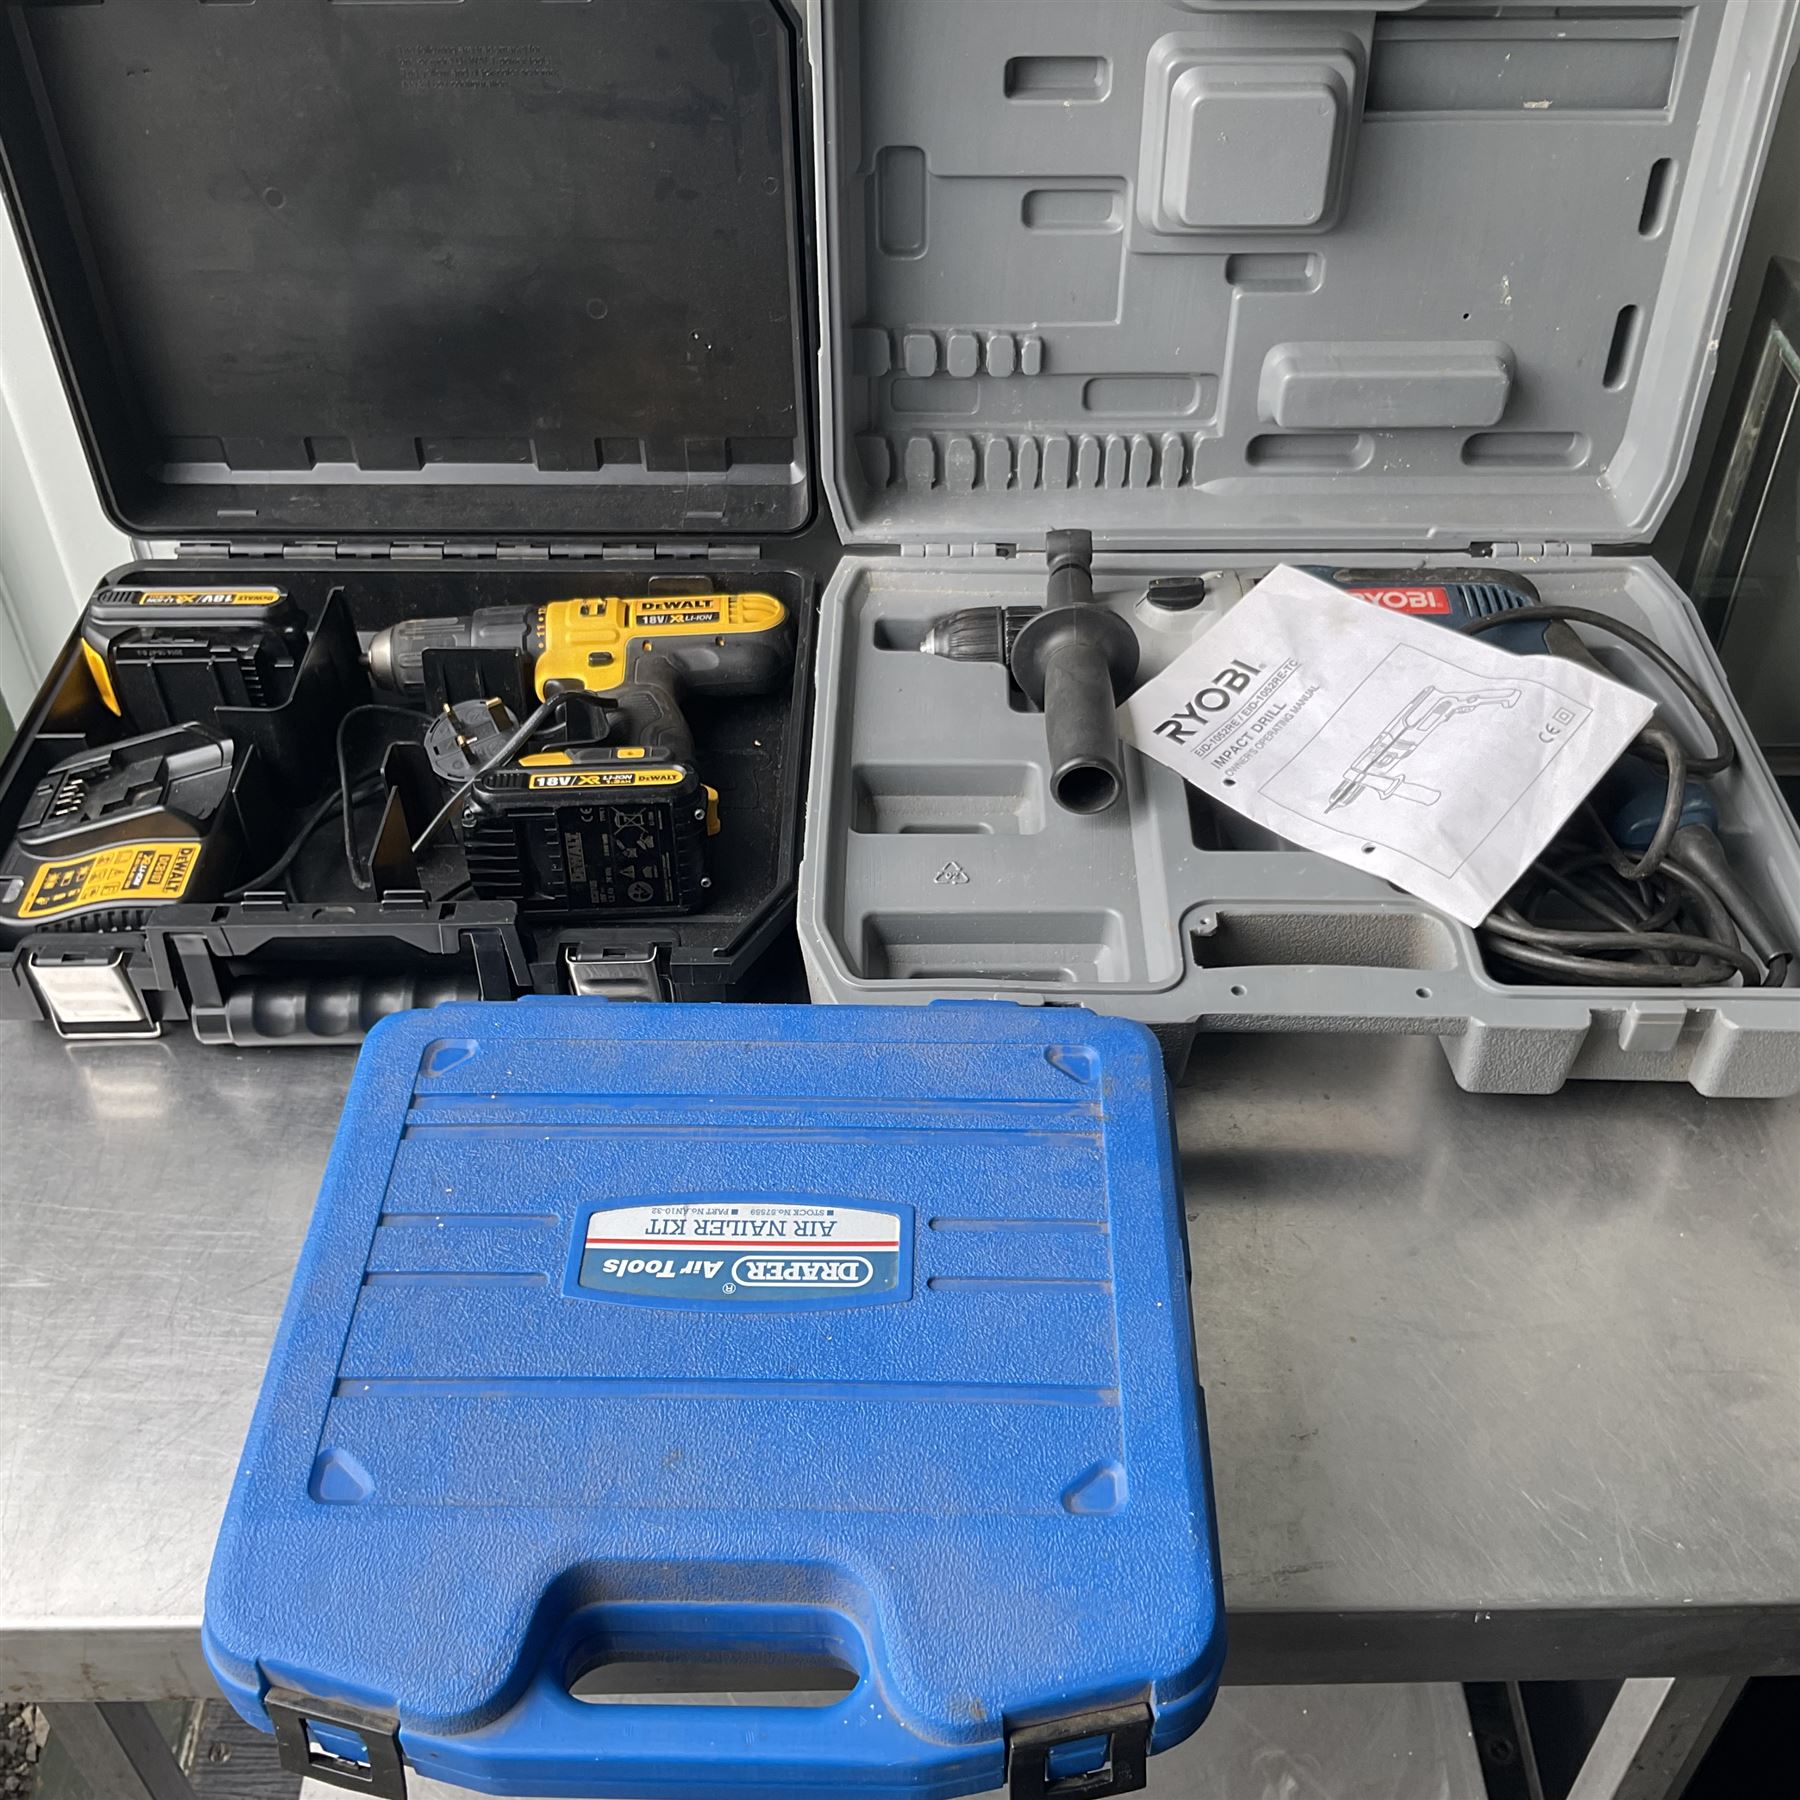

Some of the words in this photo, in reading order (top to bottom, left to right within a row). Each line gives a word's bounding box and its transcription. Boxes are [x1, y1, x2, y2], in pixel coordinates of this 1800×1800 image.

[1153, 659, 1261, 745] RYOBI
[1257, 712, 1294, 751] OPERATING
[1291, 683, 1321, 715] MANUAL
[1194, 721, 1240, 757] EID-1052RE
[1211, 731, 1254, 769] IMPACT
[1251, 701, 1288, 734] DRILL
[706, 1208, 729, 1216] PART
[793, 1209, 826, 1217] STOCK
[645, 1218, 688, 1235] KIT
[693, 1219, 787, 1237] NAILER
[793, 1220, 838, 1237] AIR
[602, 1258, 677, 1278] Tools
[680, 1261, 725, 1279] Air
[746, 1261, 859, 1280] DRAPER
